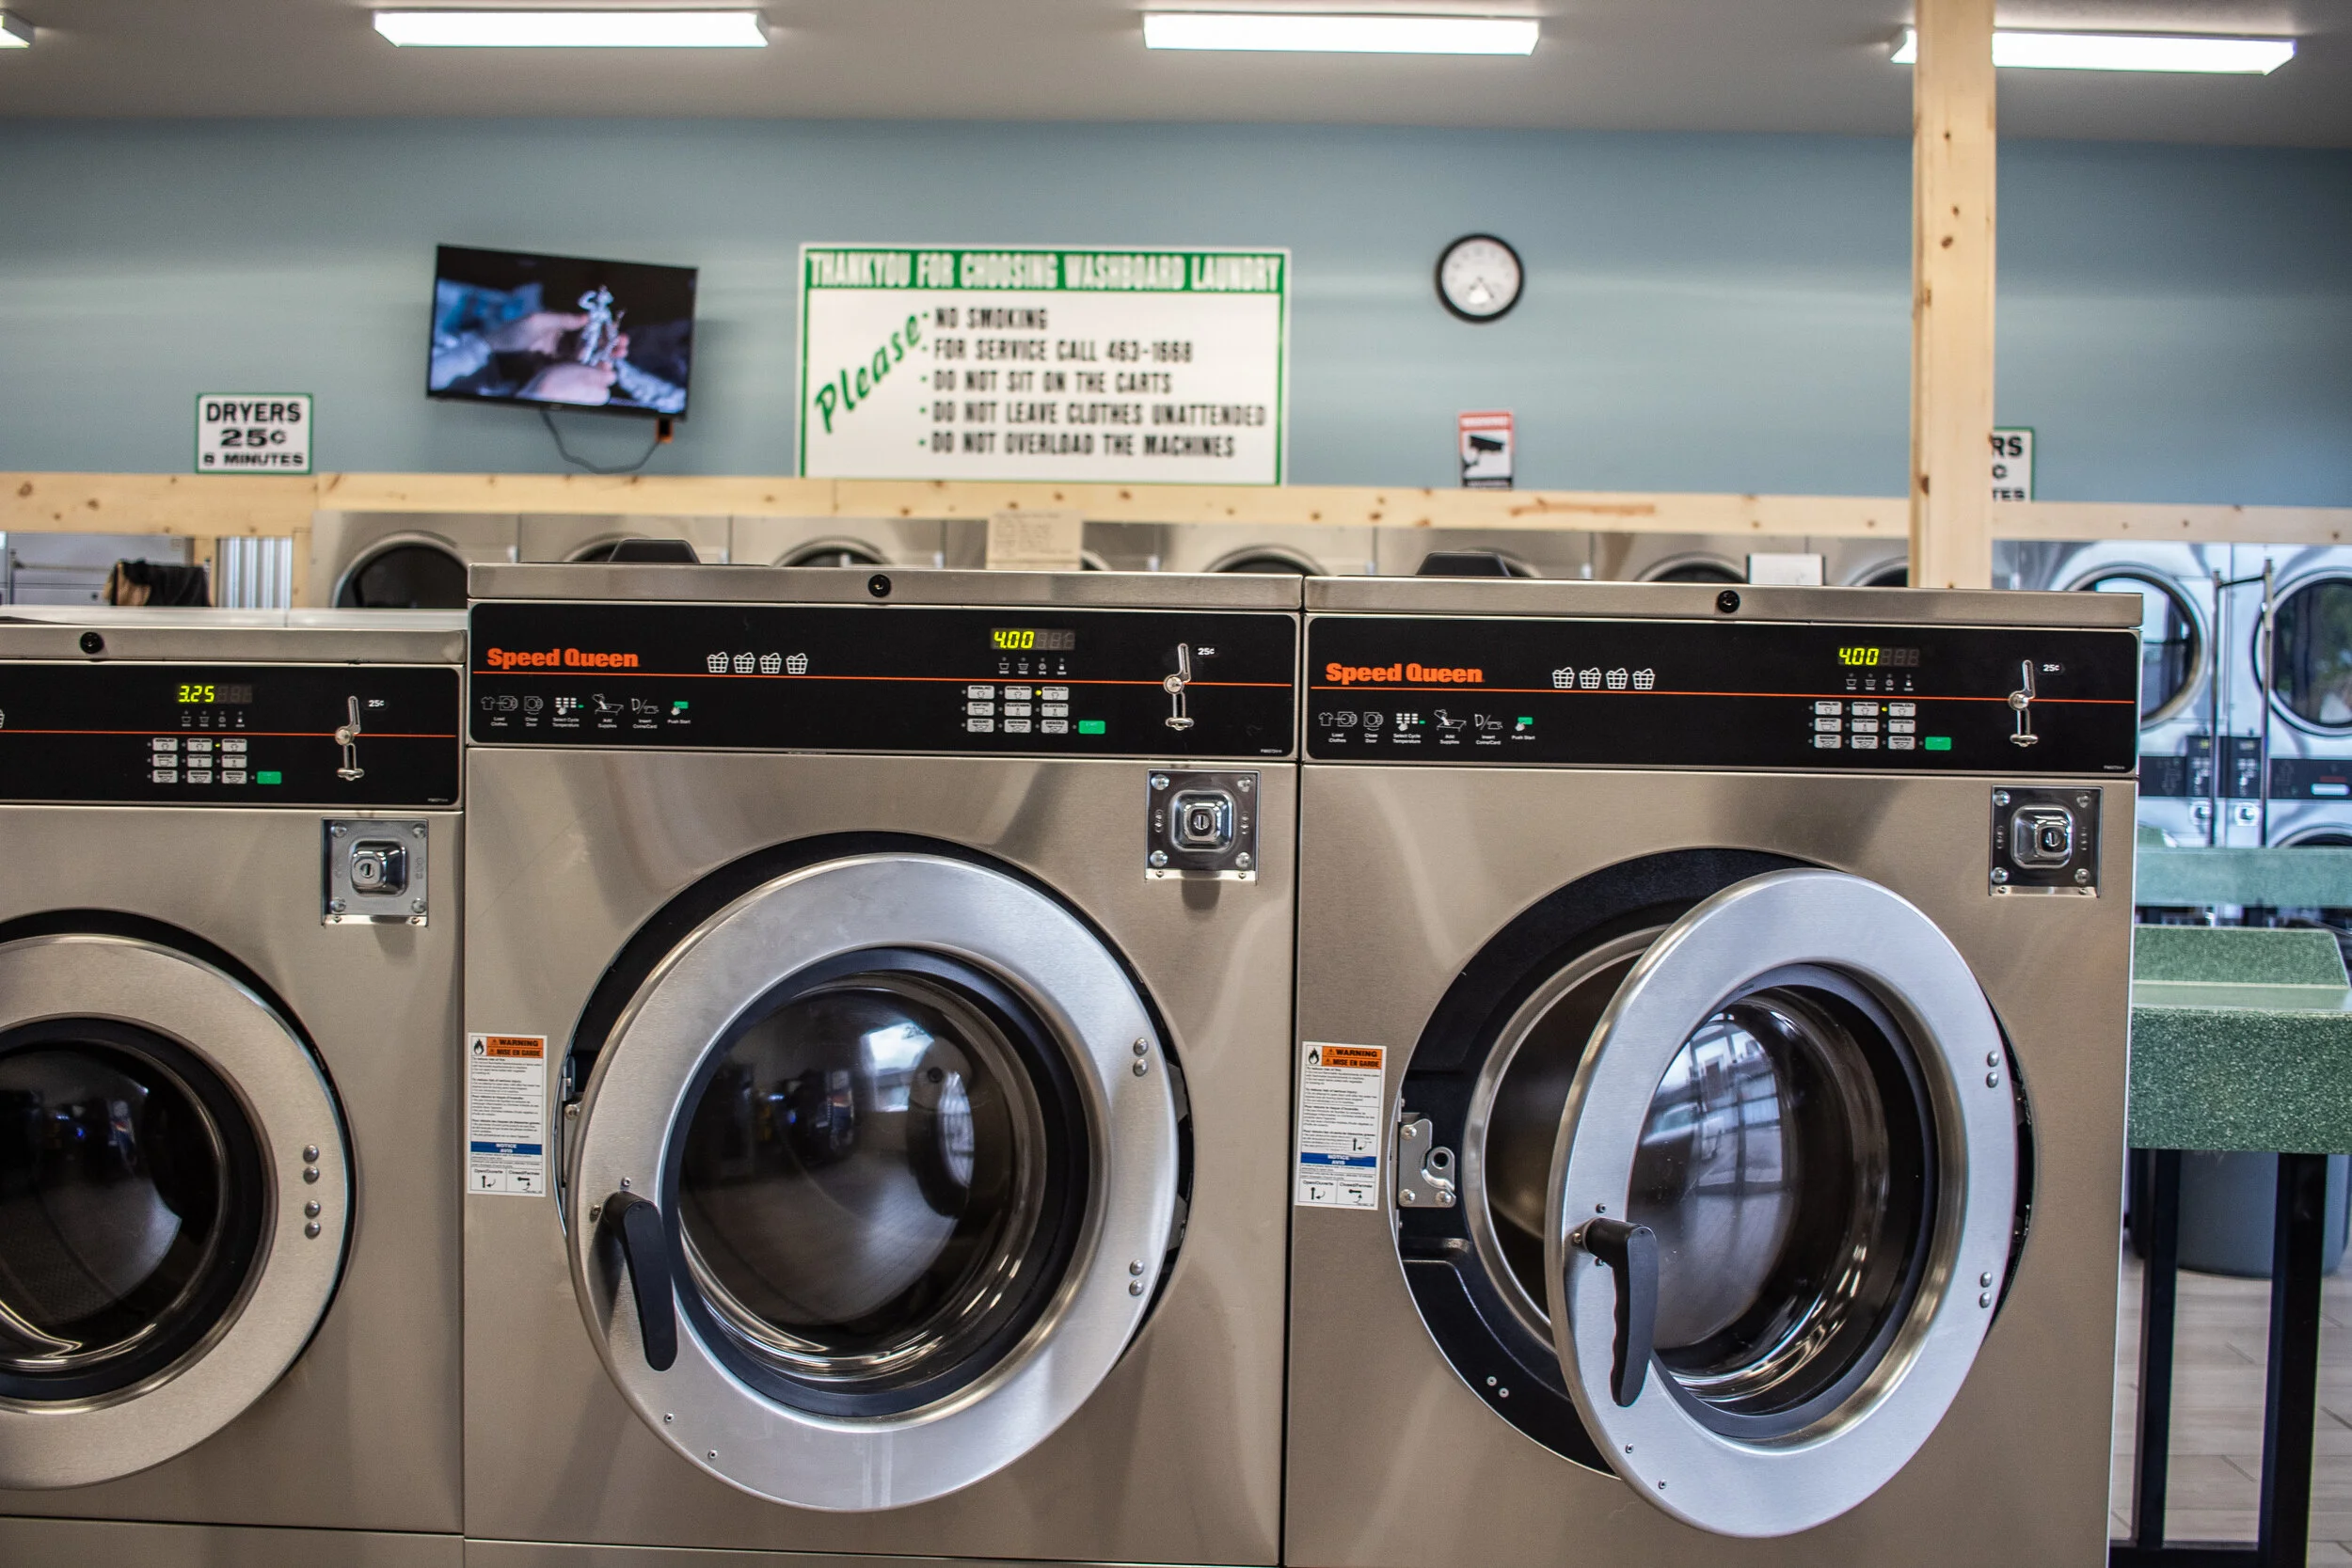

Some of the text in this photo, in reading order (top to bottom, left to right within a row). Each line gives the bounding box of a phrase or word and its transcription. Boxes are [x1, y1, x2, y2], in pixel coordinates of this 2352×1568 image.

[916, 252, 955, 288] FOR
[960, 253, 1058, 289] CHOOSING
[1064, 254, 1185, 290] WASHBOARD
[1191, 255, 1281, 292] LAUNDRY
[935, 308, 1047, 330] NO SMOKING
[935, 339, 966, 359] FOR
[976, 339, 1048, 360] SERVICE
[1057, 340, 1097, 361] CALL
[815, 314, 921, 434] Please
[934, 369, 1171, 394] DO NOT SIT ON THE CARTS
[207, 403, 301, 422] DRYERS
[932, 401, 1266, 426] DO NOT LEAVE CLOTHES UNATTENDED
[931, 432, 1234, 457] DO NOT OVERLOAD THE MACHINES
[224, 453, 303, 466] MINUTES
[993, 631, 1035, 649] 4.00
[486, 647, 639, 670] Speed Queen
[1839, 648, 1880, 665] 4.00
[1326, 662, 1484, 685] Speed Queen
[178, 685, 215, 703] 3.25
[499, 1038, 539, 1047] WARNING
[1335, 1049, 1378, 1057] WARNING
